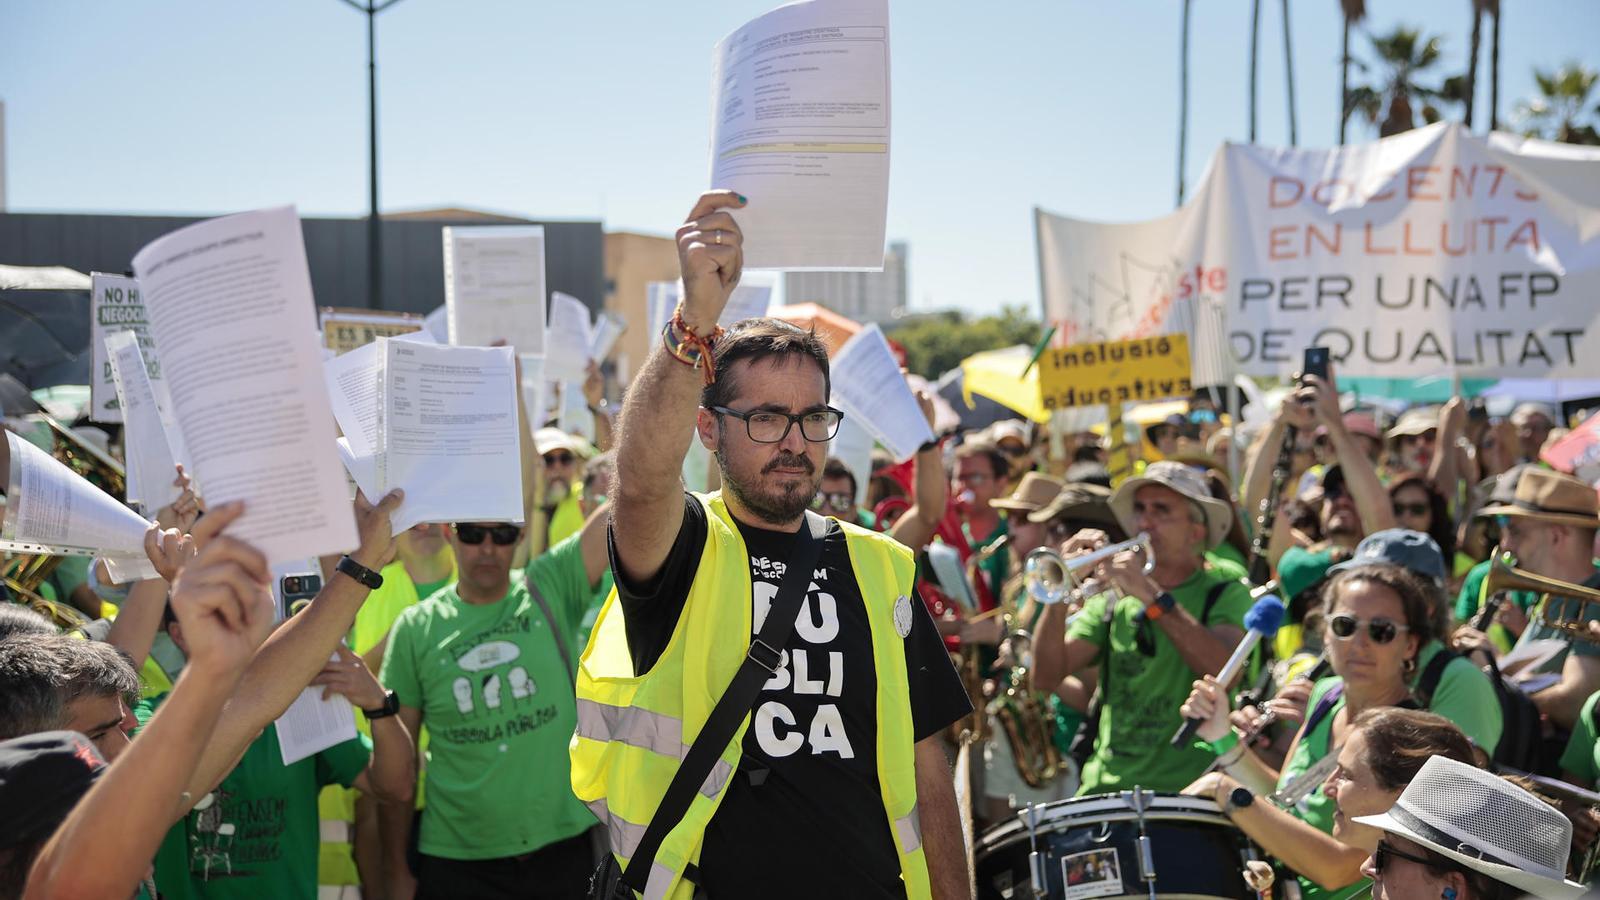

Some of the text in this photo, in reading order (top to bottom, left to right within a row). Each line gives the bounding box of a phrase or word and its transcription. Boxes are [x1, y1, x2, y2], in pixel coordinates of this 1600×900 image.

[1268, 214, 1541, 262] EN LLUITA
[104, 287, 123, 303] NO
[1239, 271, 1560, 311] PER UNA FP
[1230, 327, 1585, 366] DE QUALITAT
[755, 701, 855, 759] CA
